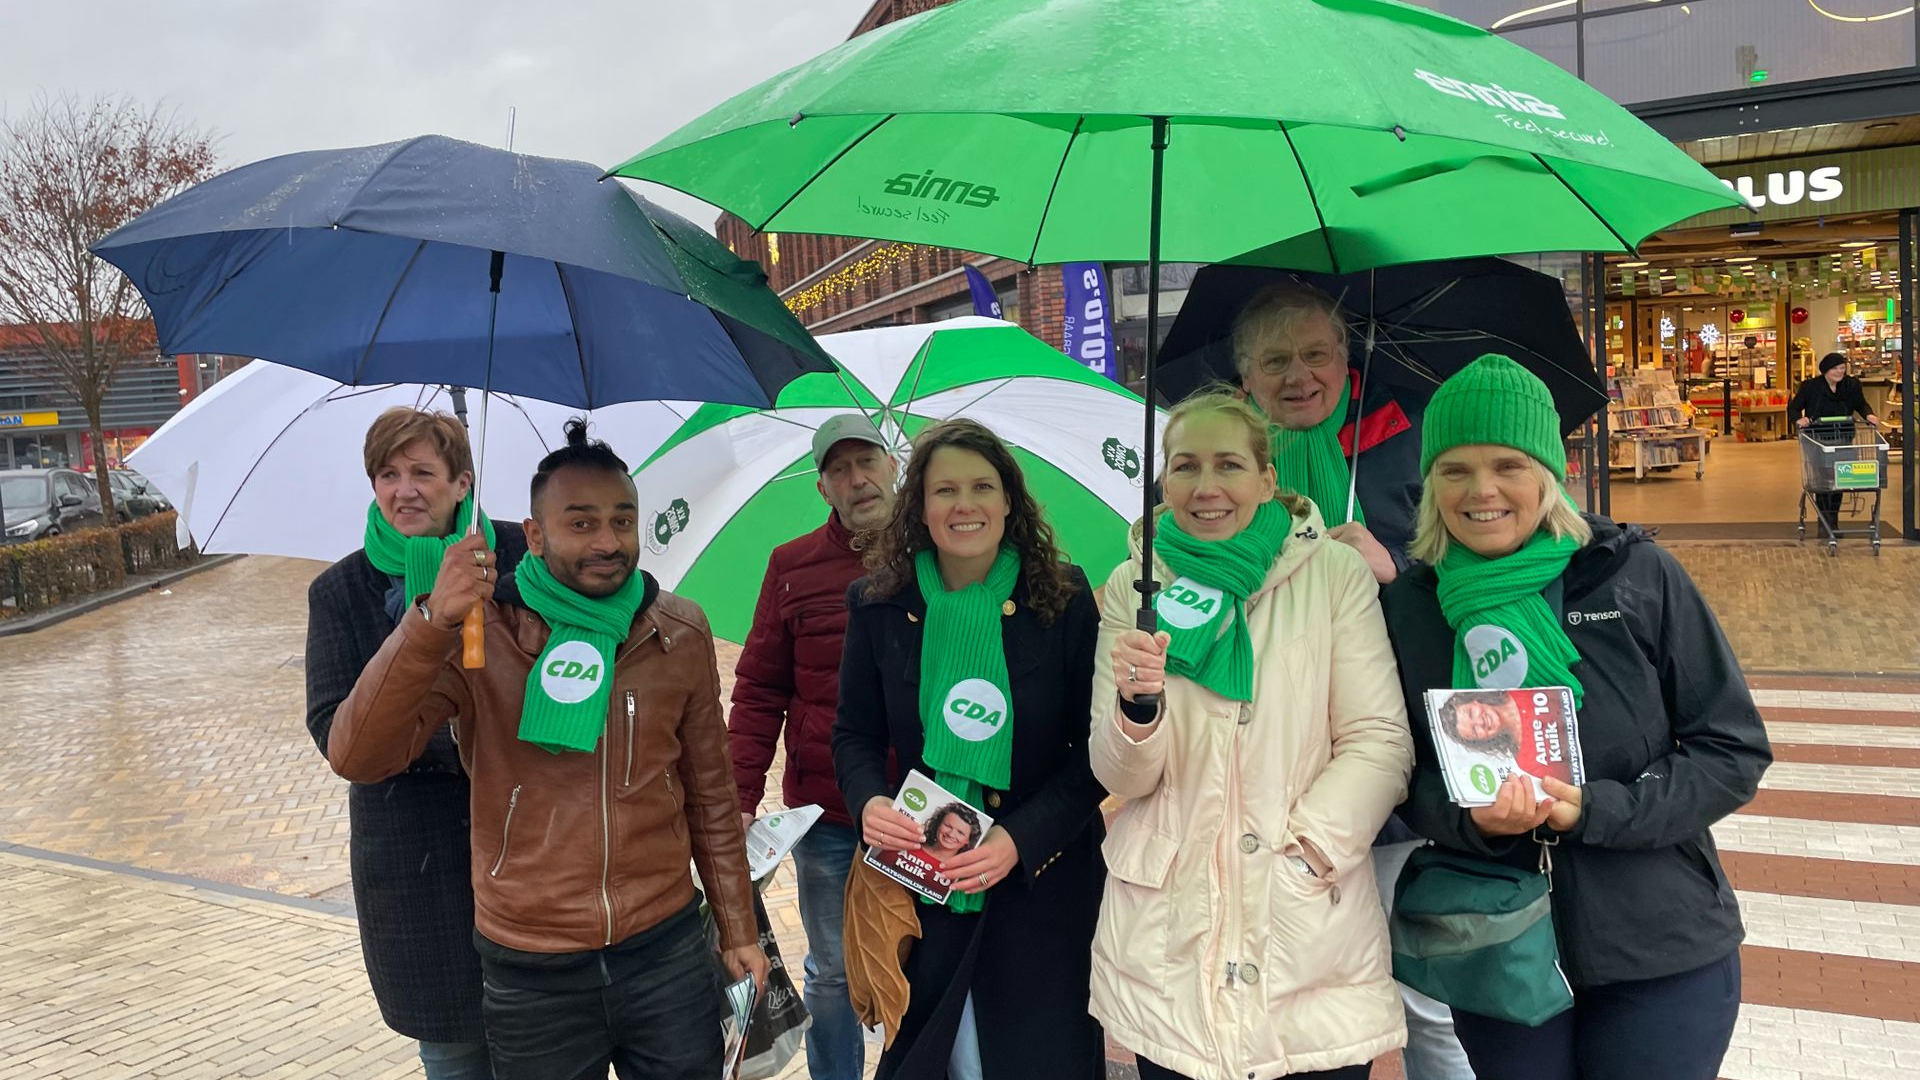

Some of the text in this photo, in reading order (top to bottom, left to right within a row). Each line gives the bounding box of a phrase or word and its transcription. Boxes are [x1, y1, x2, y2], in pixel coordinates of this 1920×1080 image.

[1414, 68, 1567, 119] ennia
[1495, 114, 1615, 148] Feel secure!
[1719, 166, 1843, 208] LUS
[1163, 585, 1216, 615] CDA
[1584, 610, 1621, 621] Tenson
[546, 660, 599, 681] CDA
[1477, 637, 1518, 679] CDA
[950, 698, 1002, 727] CDA
[1533, 692, 1549, 766] Anne 10
[1545, 721, 1562, 762] Kuik
[905, 791, 925, 808] CDA
[895, 858, 927, 880] Kuik
[898, 849, 933, 871] Anne
